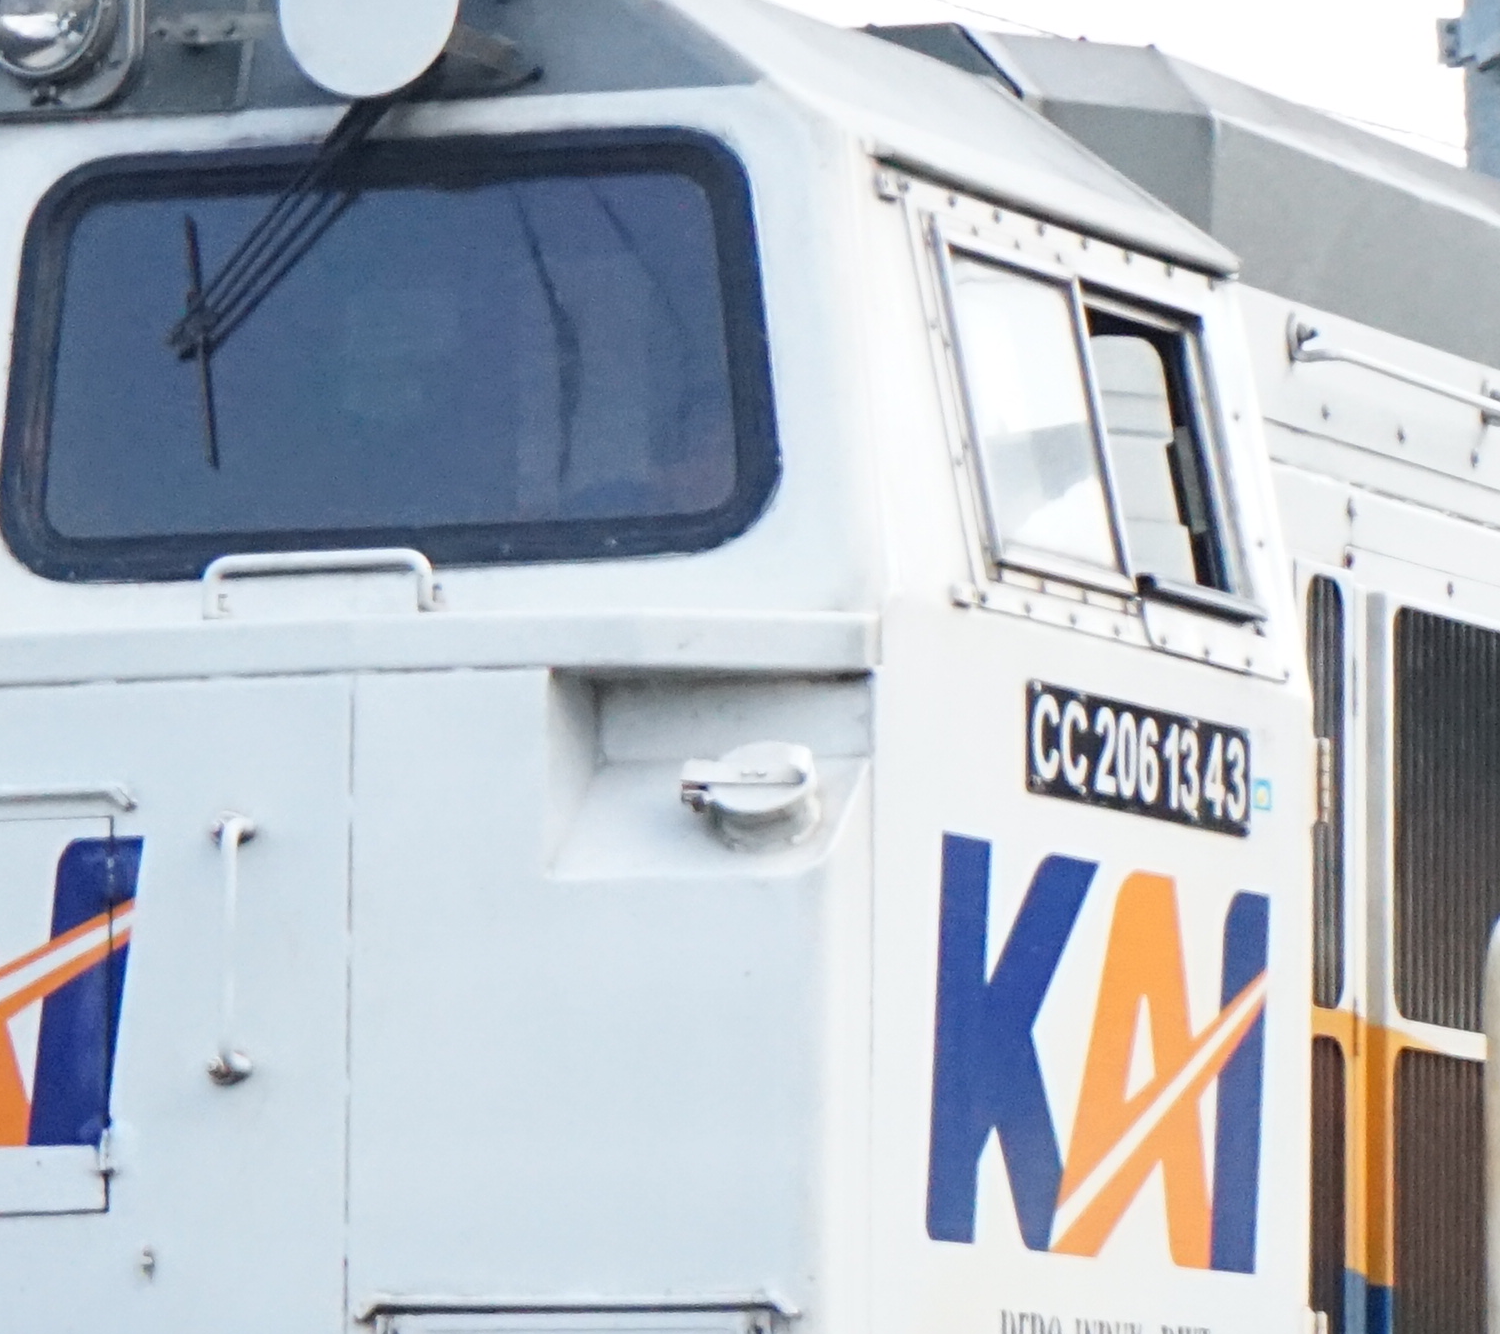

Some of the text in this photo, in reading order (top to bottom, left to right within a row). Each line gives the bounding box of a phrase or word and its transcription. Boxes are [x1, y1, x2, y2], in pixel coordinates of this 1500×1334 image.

[1031, 693, 1089, 788] CC
[1094, 706, 1160, 805] 206
[1203, 732, 1246, 822] 43
[925, 831, 1271, 1275] KAI
